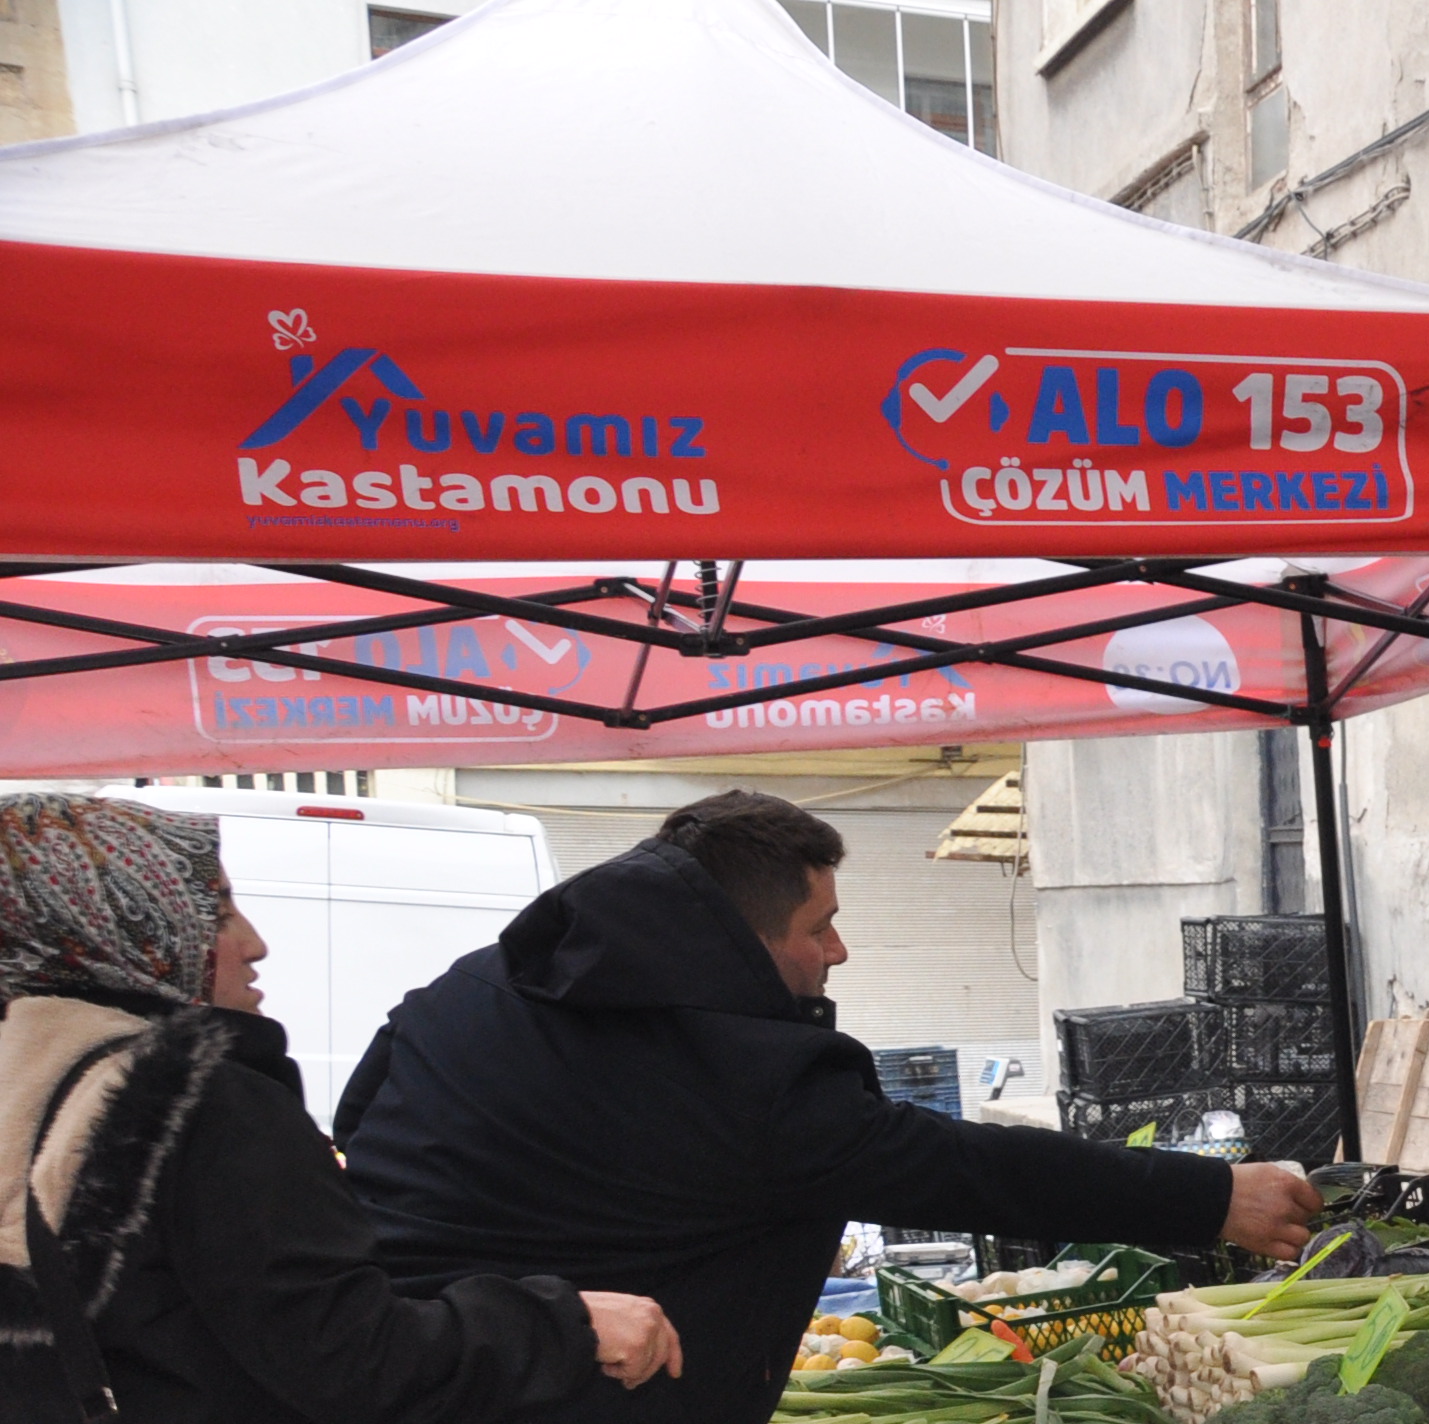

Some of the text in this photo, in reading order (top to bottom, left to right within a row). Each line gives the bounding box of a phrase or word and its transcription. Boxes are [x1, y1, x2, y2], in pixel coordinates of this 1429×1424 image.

[340, 397, 706, 459] Yuvamız
[1026, 365, 1385, 453] ALO 153
[237, 456, 721, 515] Kastamonu
[960, 455, 1389, 517] ÇÖZÜM MERKEZİ
